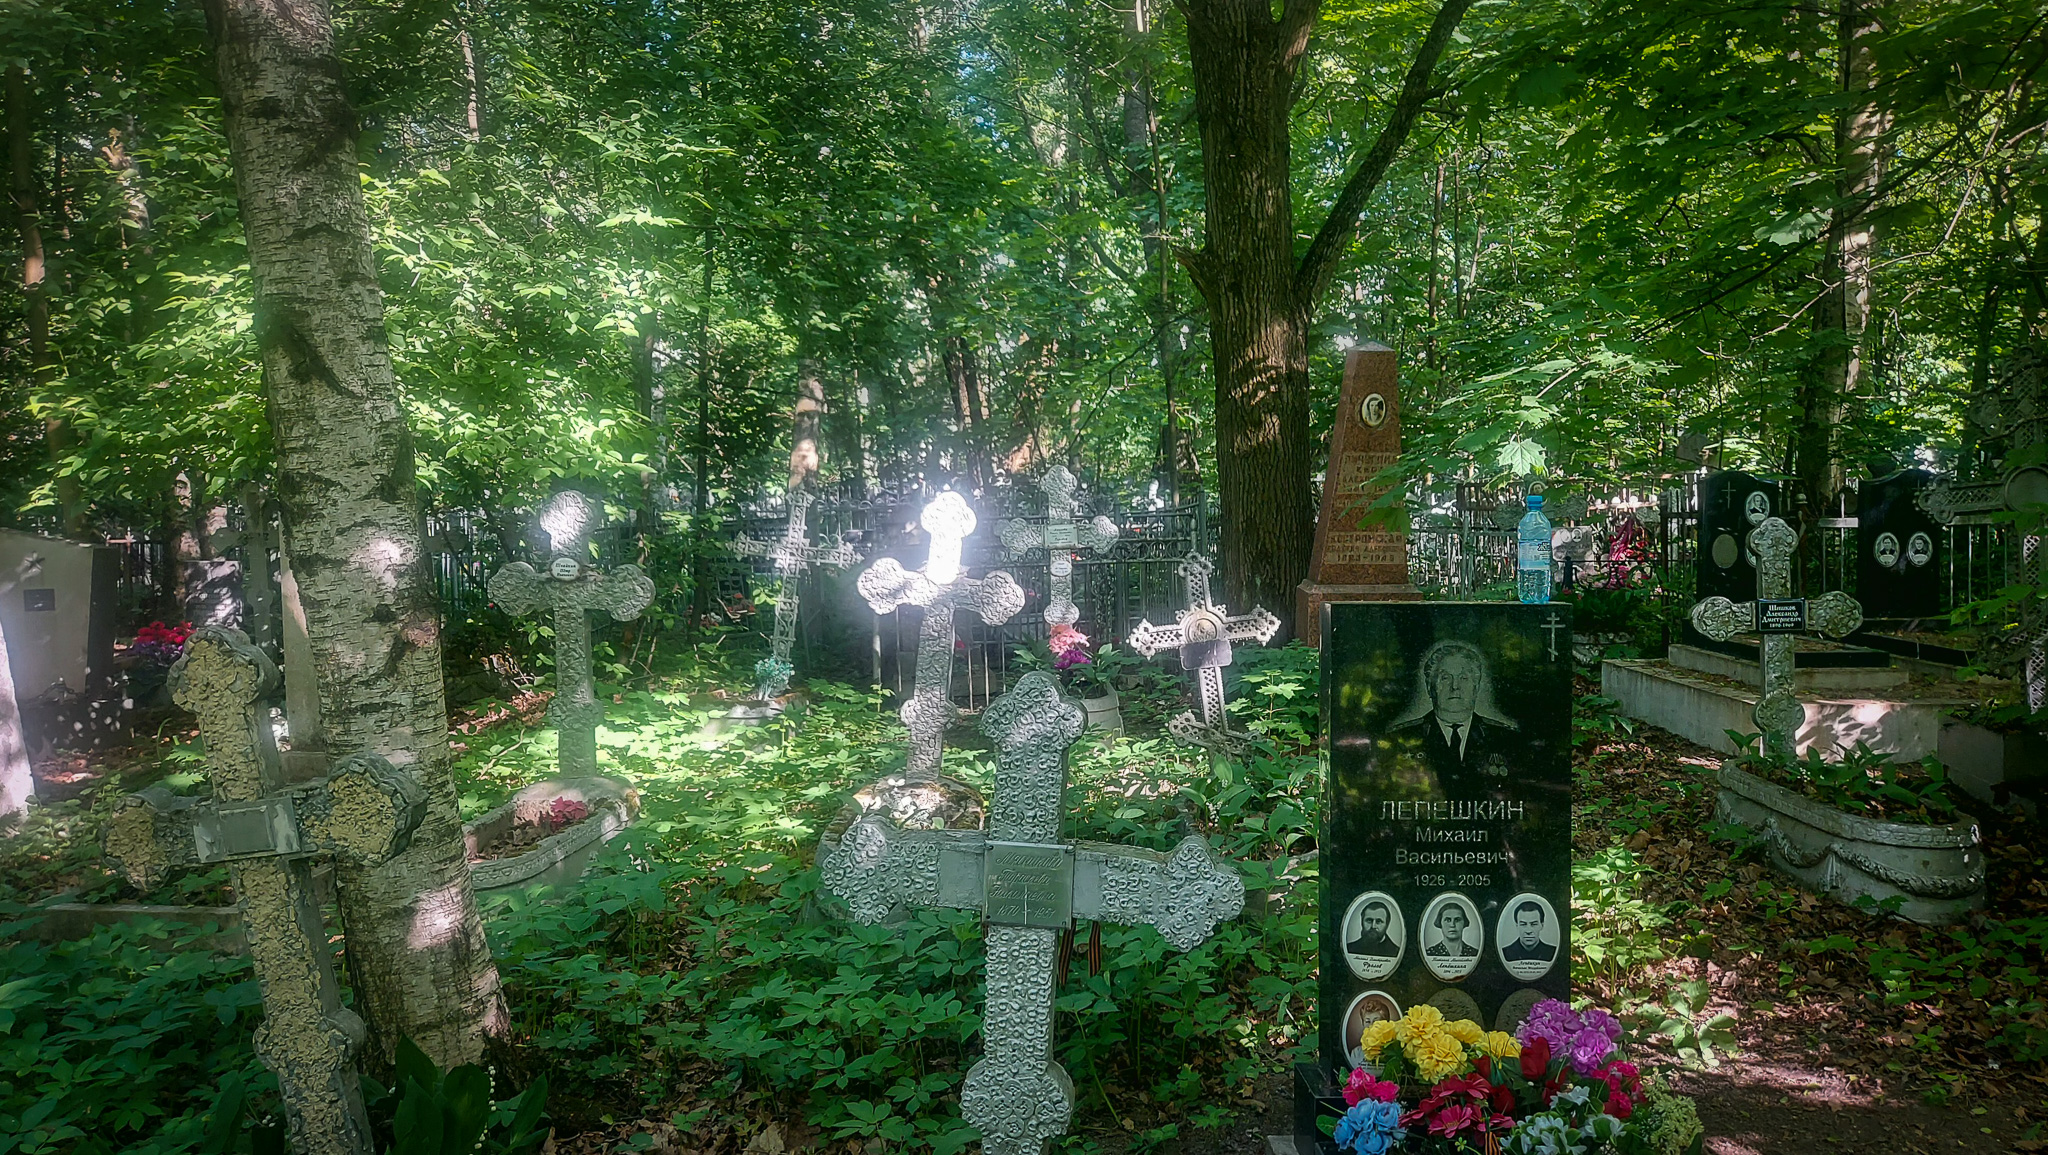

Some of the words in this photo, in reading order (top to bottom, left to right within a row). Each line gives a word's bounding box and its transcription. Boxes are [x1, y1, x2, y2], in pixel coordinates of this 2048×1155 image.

[1380, 800, 1524, 820] ЛЕПЕШКИН
[1415, 826, 1489, 842] Михаил
[1395, 848, 1508, 865] Васильевич
[1414, 874, 1446, 886] 1926
[1458, 874, 1491, 886] 2005
